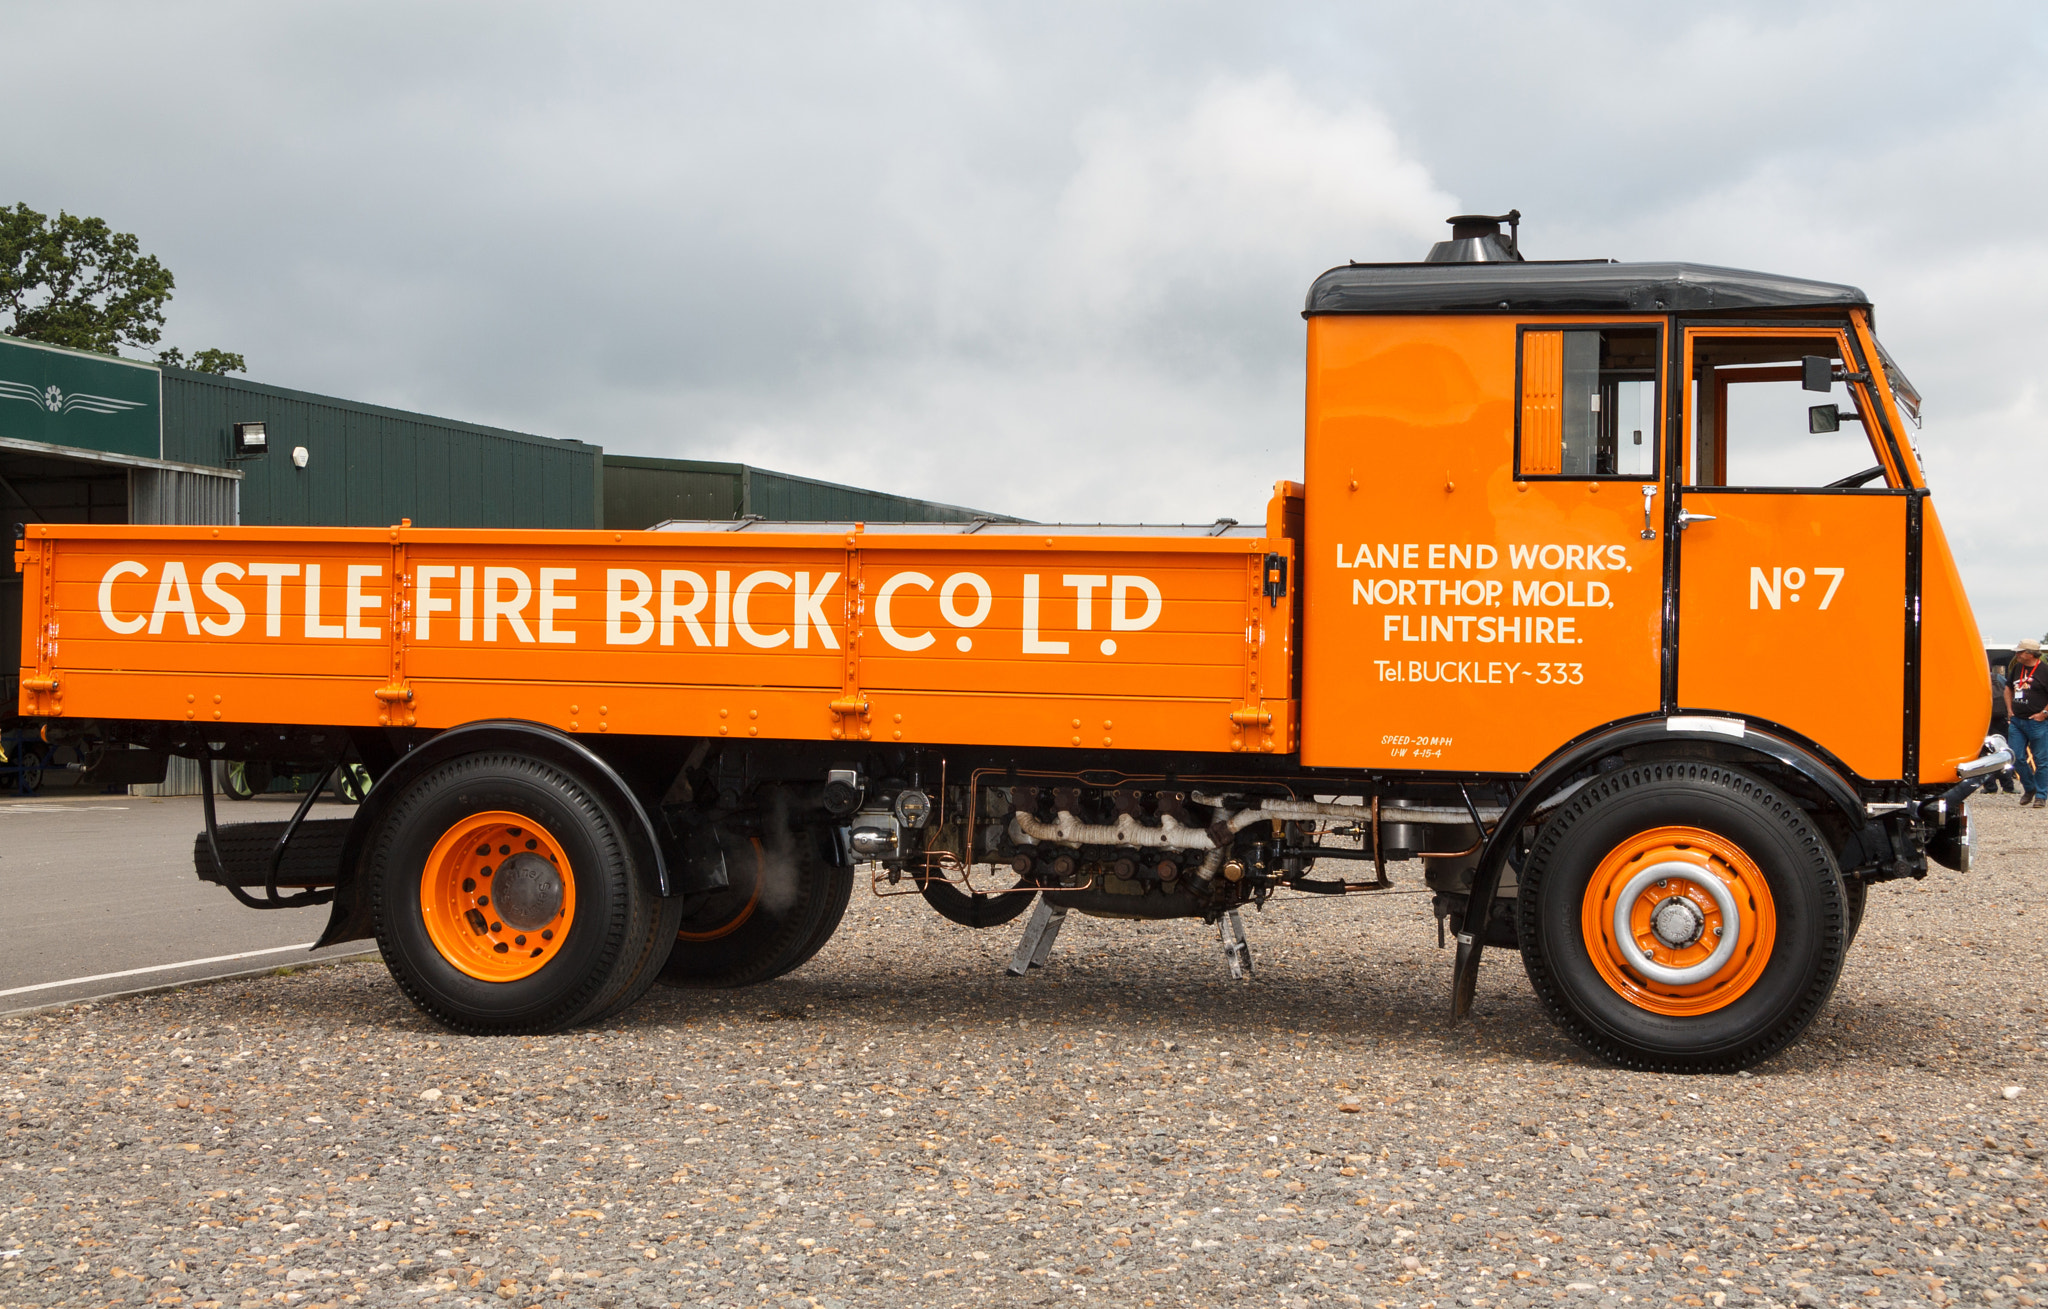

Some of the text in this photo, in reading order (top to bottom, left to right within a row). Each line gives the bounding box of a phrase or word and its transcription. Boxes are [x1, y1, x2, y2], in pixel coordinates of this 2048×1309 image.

[1336, 543, 1633, 574] LANE END WORKS,
[1352, 578, 1614, 610] NORTHOP, MOLD,
[1814, 567, 1845, 610] 7
[97, 560, 383, 640] CASTLE
[415, 565, 577, 644] FIRE
[605, 568, 841, 650] BRICK
[1384, 615, 1584, 644] FLINTSHIRE.
